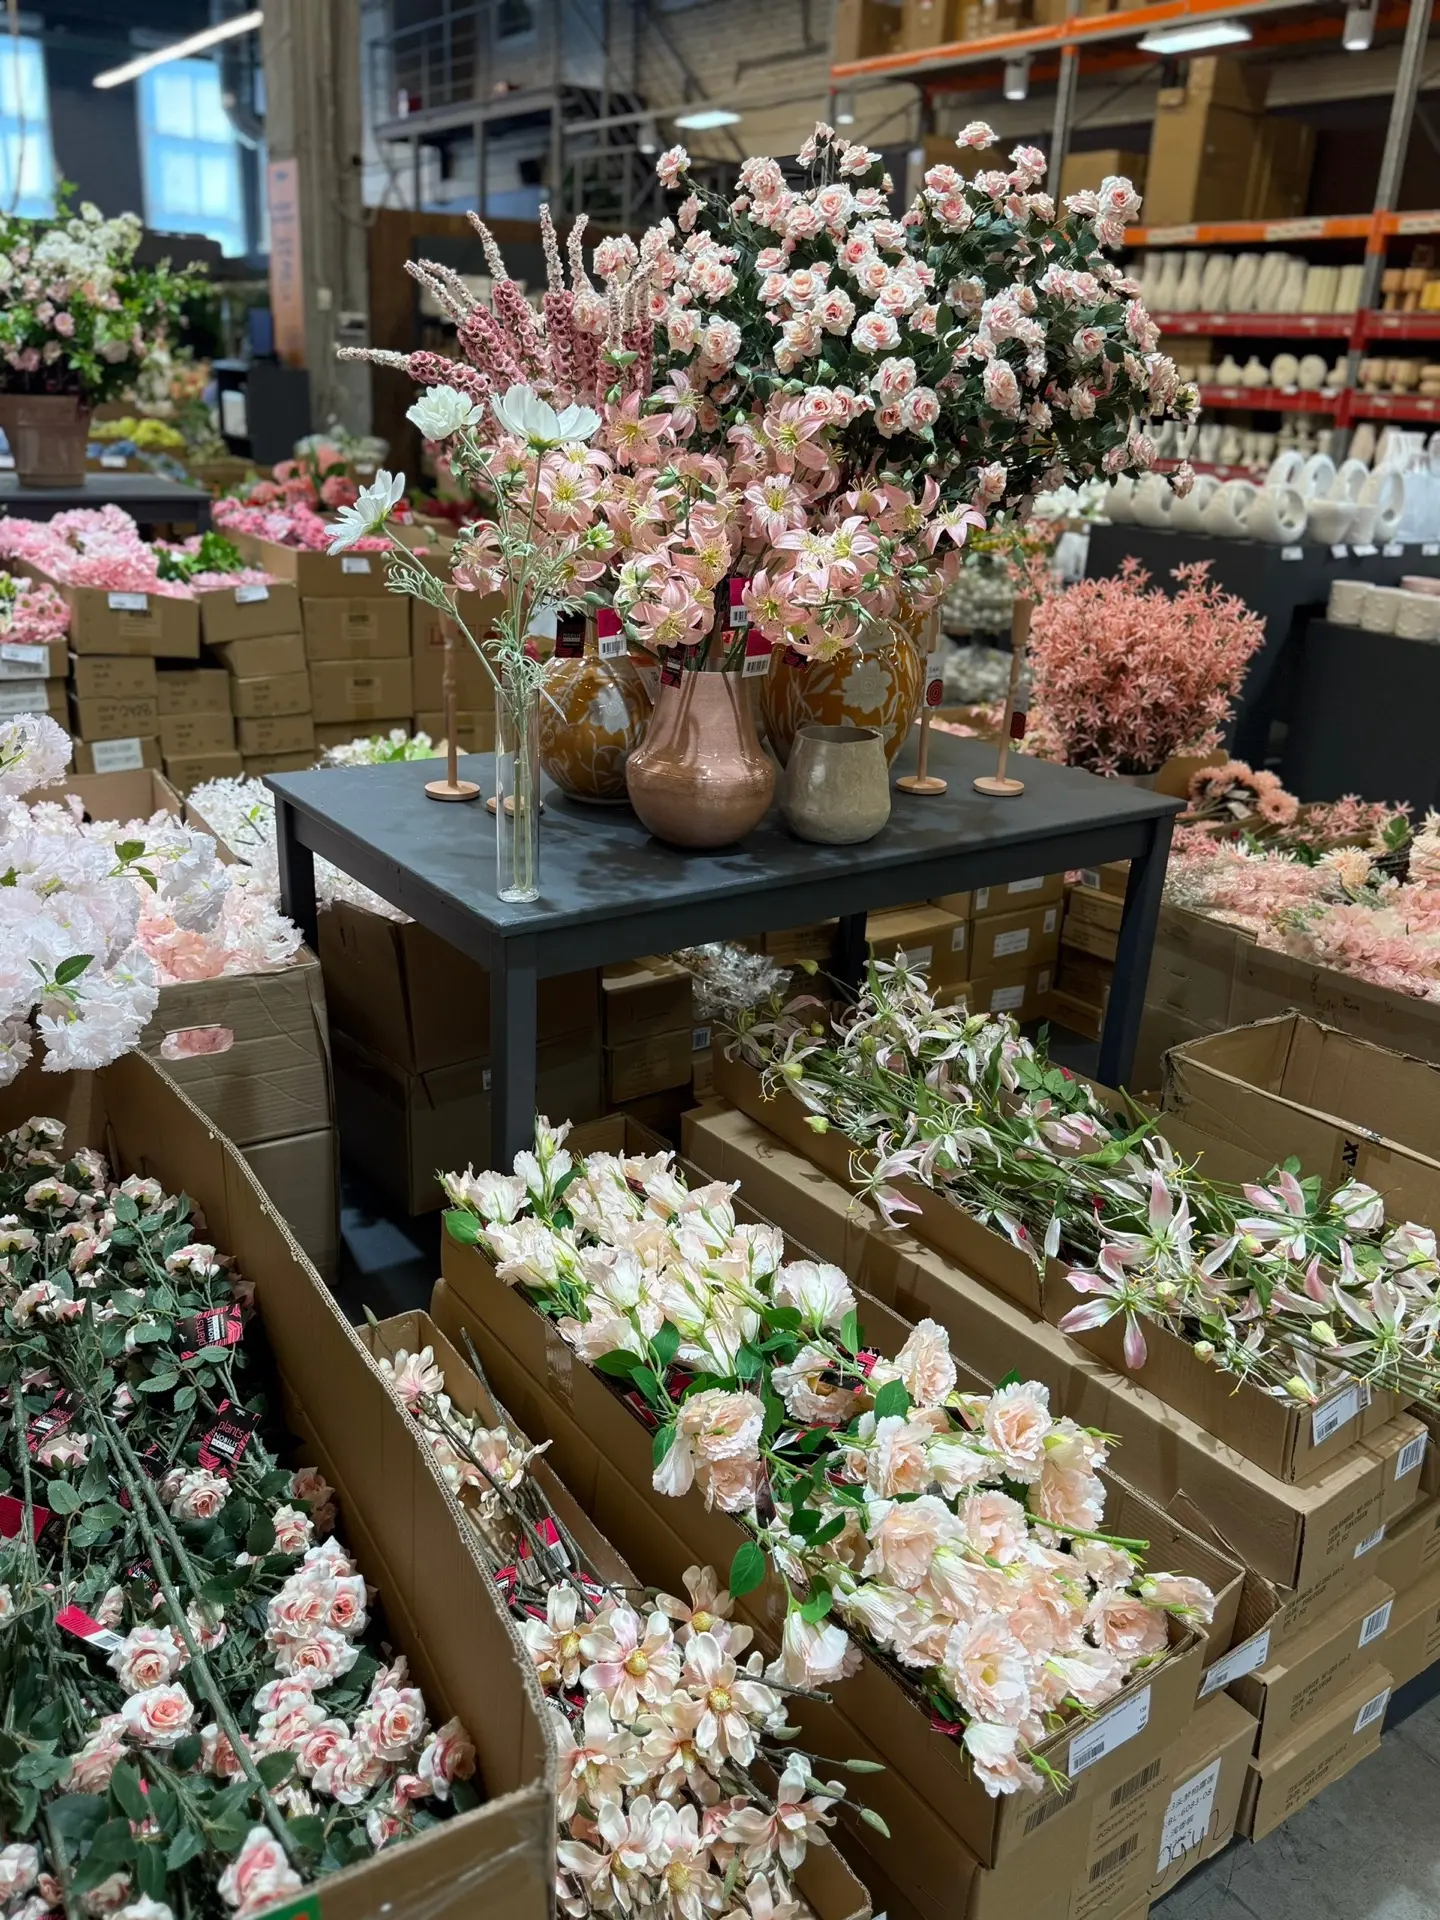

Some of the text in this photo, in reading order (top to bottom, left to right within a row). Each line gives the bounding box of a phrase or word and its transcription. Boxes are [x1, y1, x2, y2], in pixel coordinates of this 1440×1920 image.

[195, 1318, 206, 1347] plants
[217, 1420, 245, 1439] plants
[213, 1431, 239, 1448] NOBILIS
